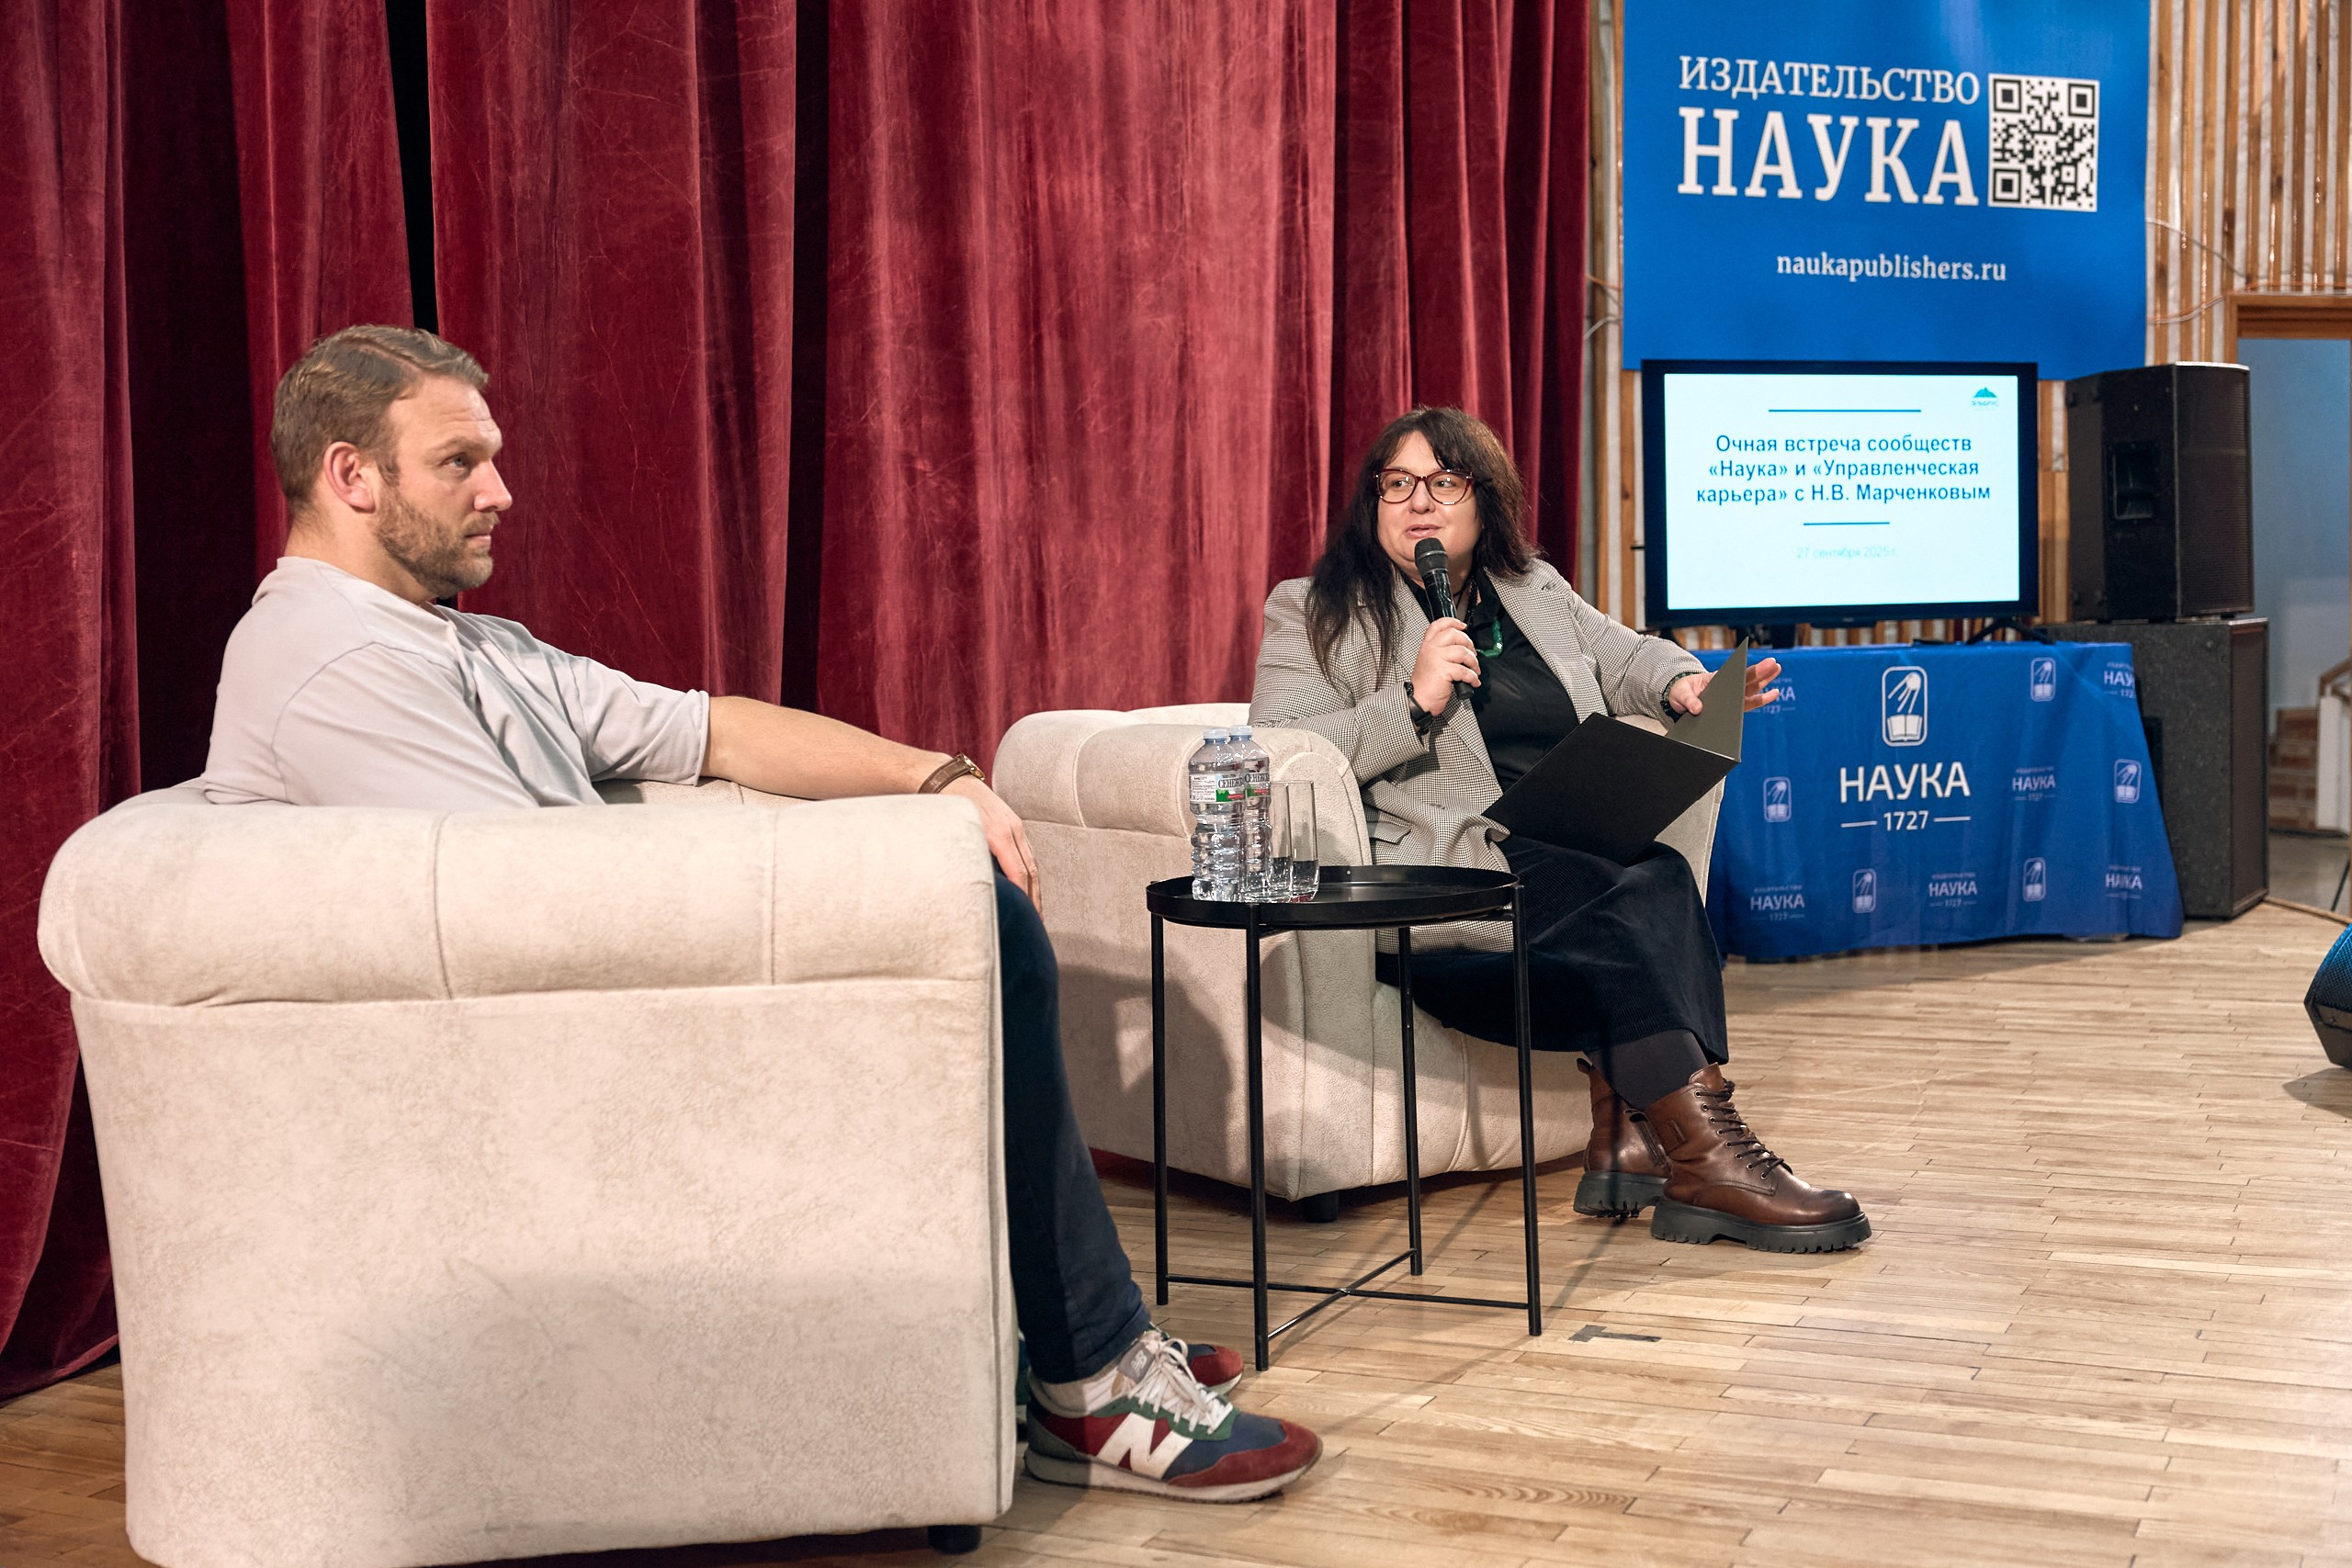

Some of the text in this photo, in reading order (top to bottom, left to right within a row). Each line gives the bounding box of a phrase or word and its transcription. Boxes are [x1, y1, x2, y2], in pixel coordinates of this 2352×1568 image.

[1679, 55, 1980, 105] ИЗДАТЕЛЬСТВО
[1677, 107, 1980, 206] НАУКА
[1776, 251, 2007, 282] naukapublishers.ru
[1715, 434, 1972, 456] Очная встреча сообществ
[1709, 459, 1979, 480] «Наука» и «Управленческая
[1697, 483, 1991, 506] карьера» с Н.В. Марченковым
[1840, 761, 1971, 803] НАУКА
[2012, 774, 2056, 792] НАУКА
[1883, 810, 1929, 831] 1727
[1928, 880, 1978, 897] НАУКА
[1750, 893, 1805, 910] НАУКА
[1096, 1412, 1193, 1480] N
